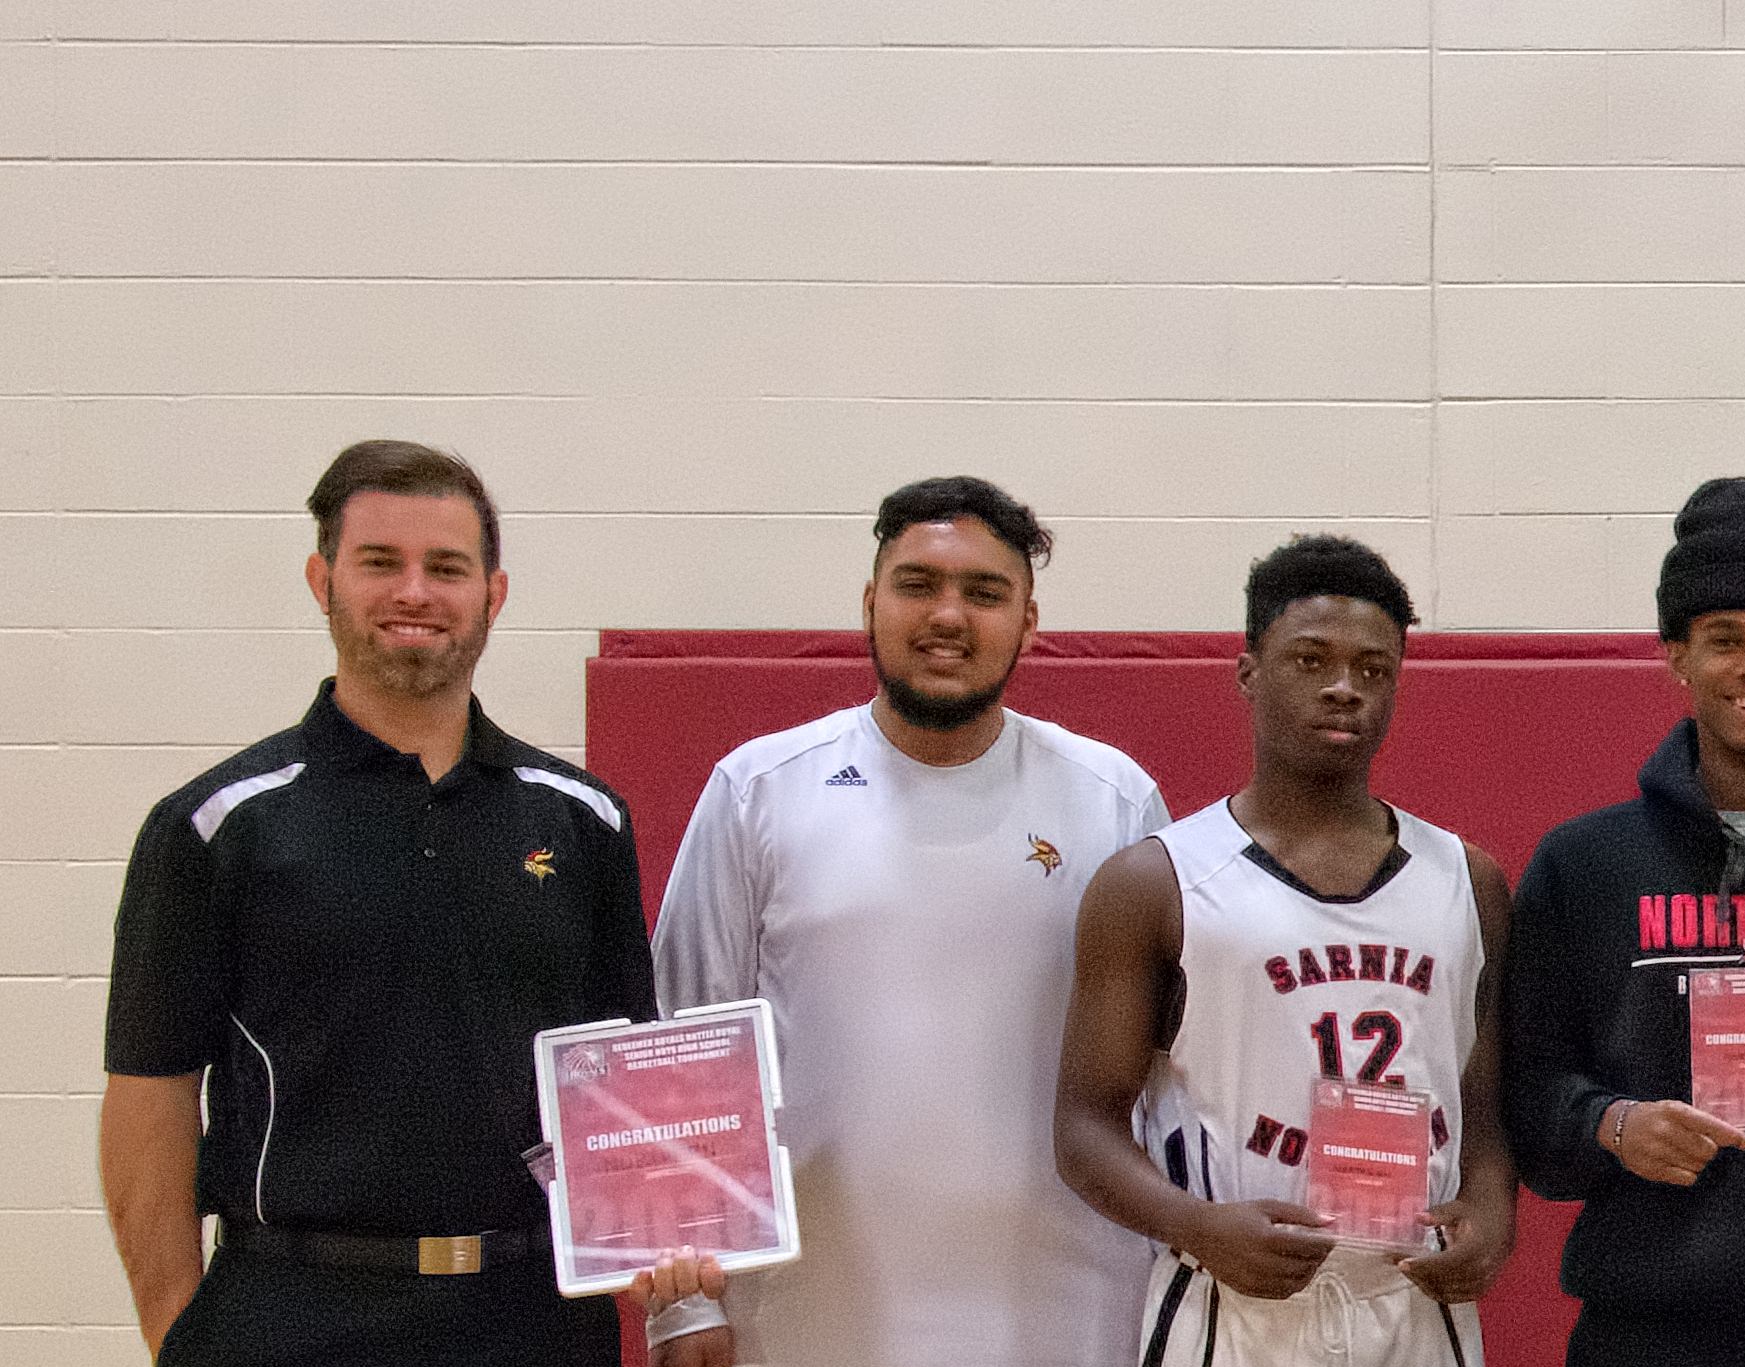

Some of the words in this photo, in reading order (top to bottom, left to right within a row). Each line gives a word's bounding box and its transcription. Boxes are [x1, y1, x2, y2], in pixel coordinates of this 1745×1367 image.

[825, 778, 868, 786] adidas
[1264, 943, 1435, 995] SARNIA
[1310, 1010, 1405, 1090] 12
[586, 1114, 742, 1151] CONGRATULATIONS
[1323, 1144, 1417, 1166] CONGRATULATIONS
